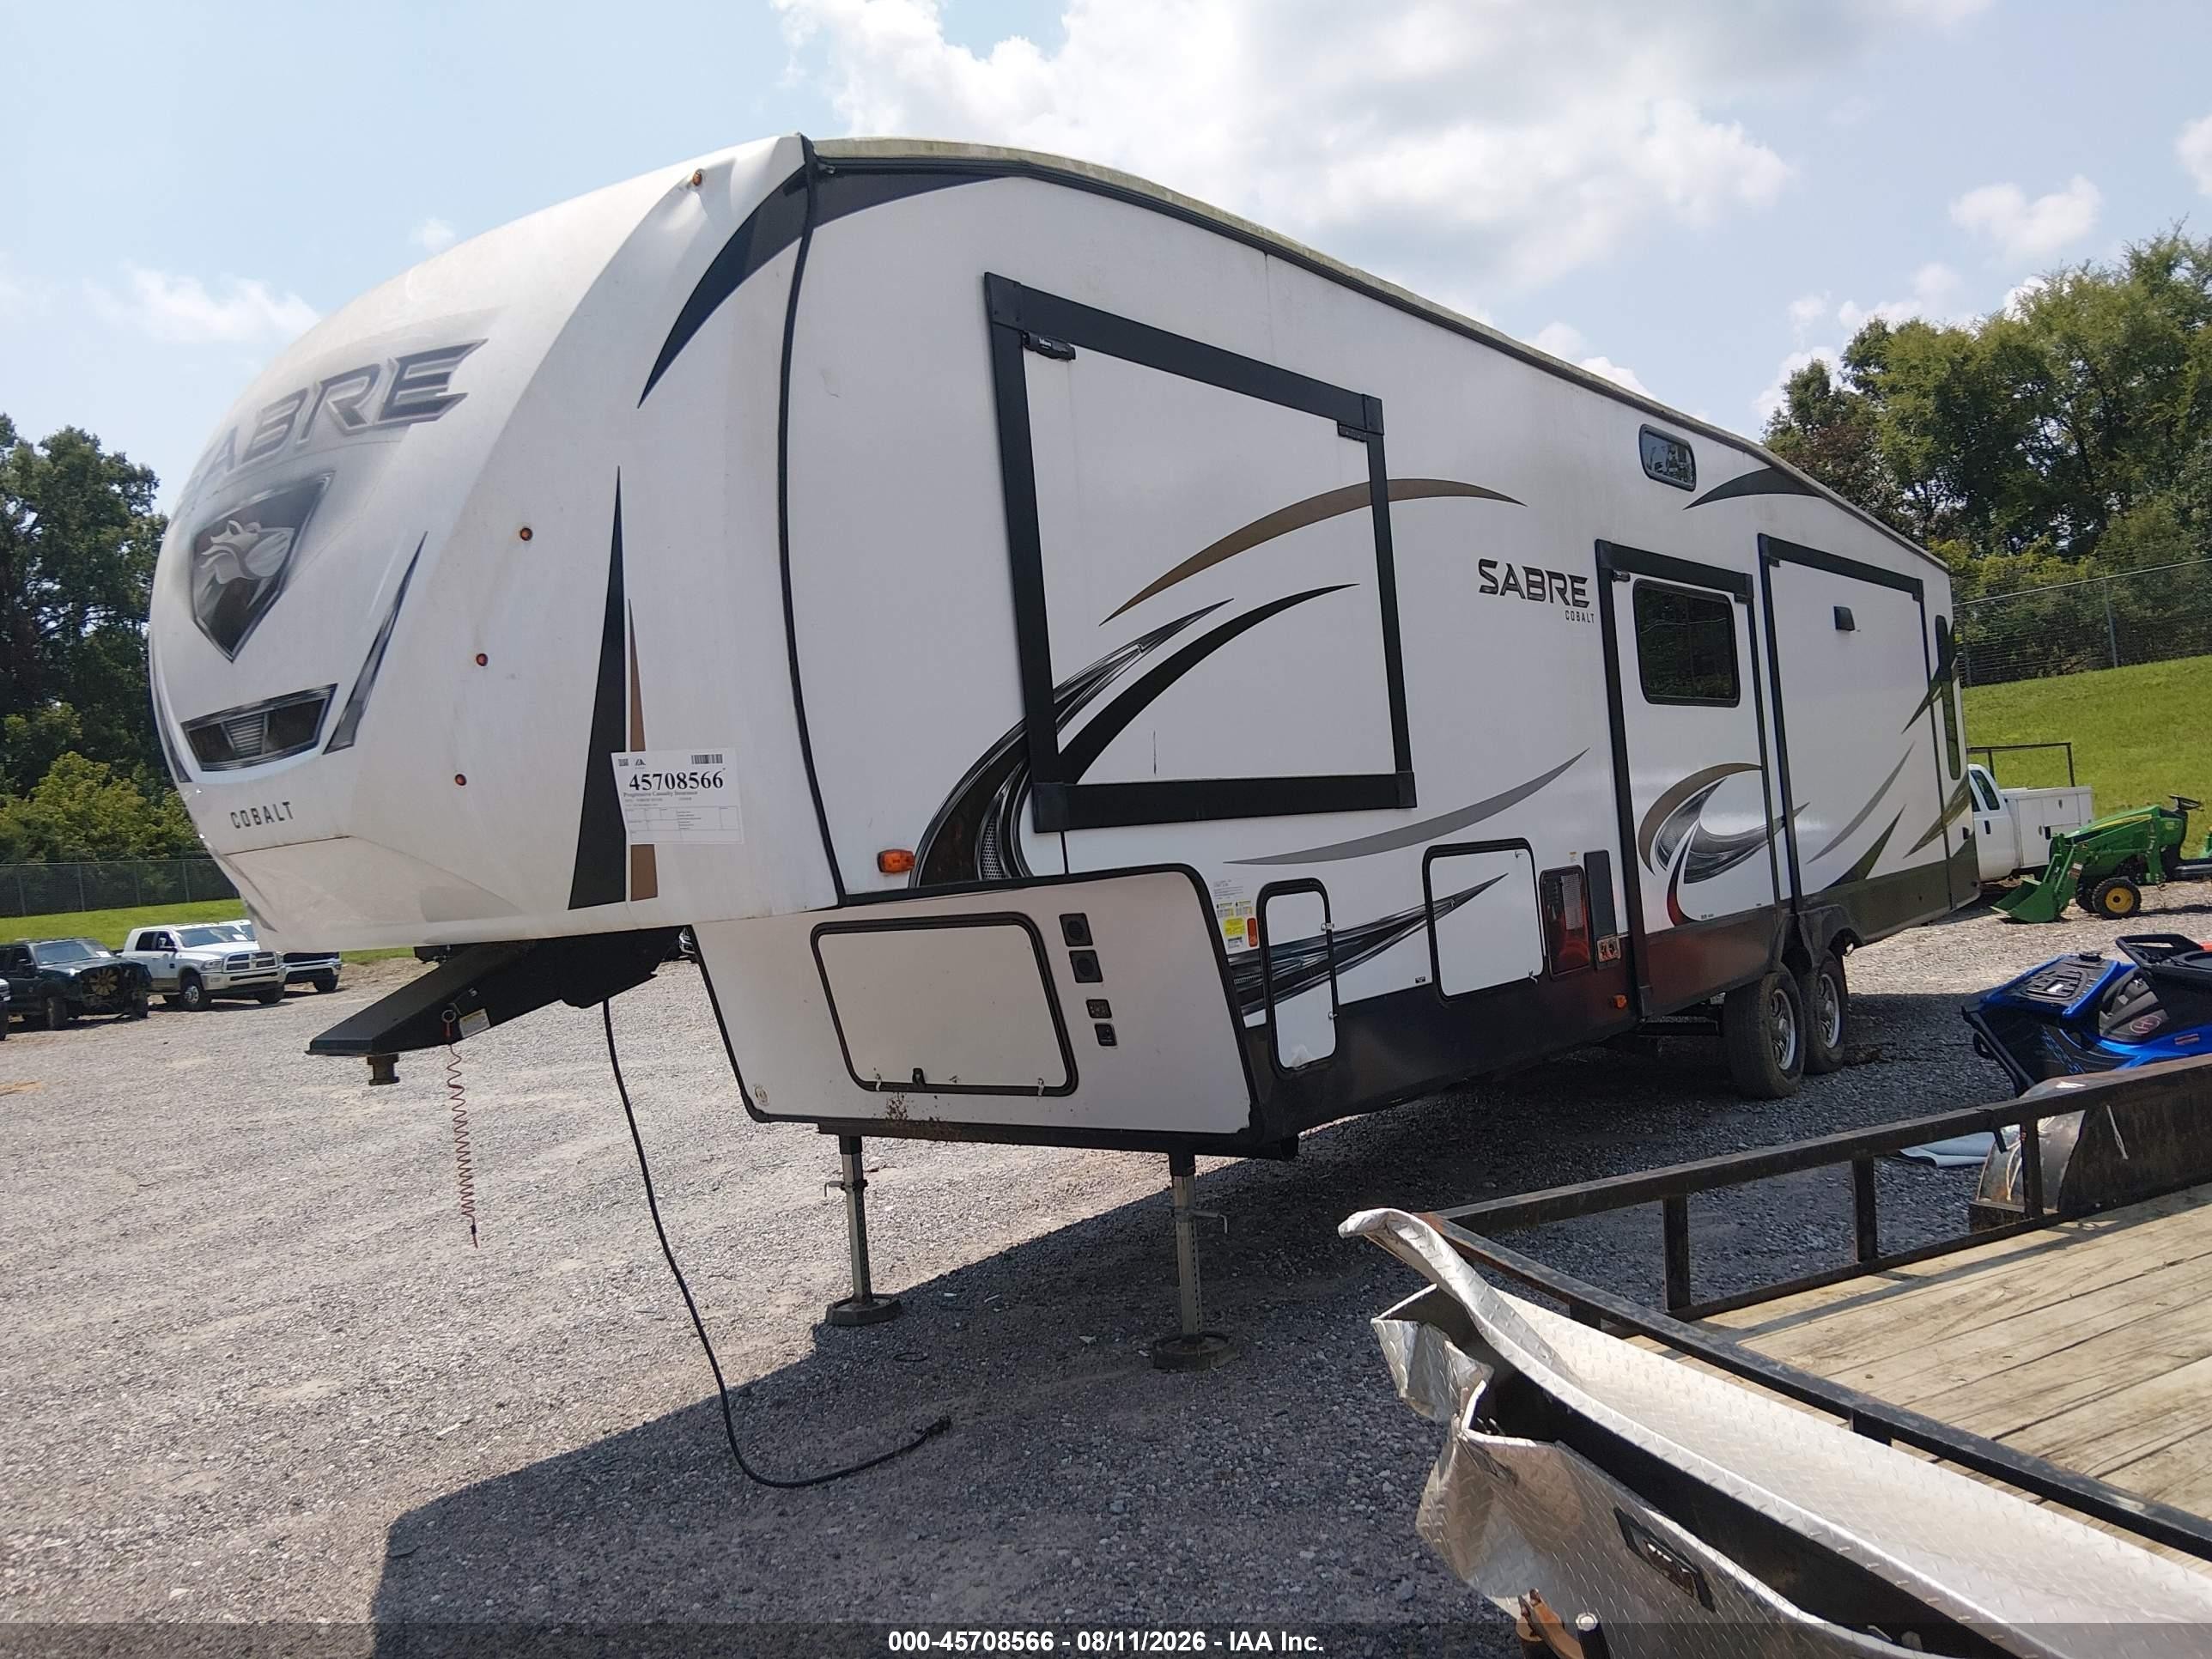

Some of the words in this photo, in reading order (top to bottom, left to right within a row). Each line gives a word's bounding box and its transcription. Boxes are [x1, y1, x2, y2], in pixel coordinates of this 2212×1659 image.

[1478, 558, 1590, 609] SABRE
[1565, 610, 1595, 623] COBALT
[629, 771, 724, 791] 45708566
[230, 801, 294, 830] COBALT
